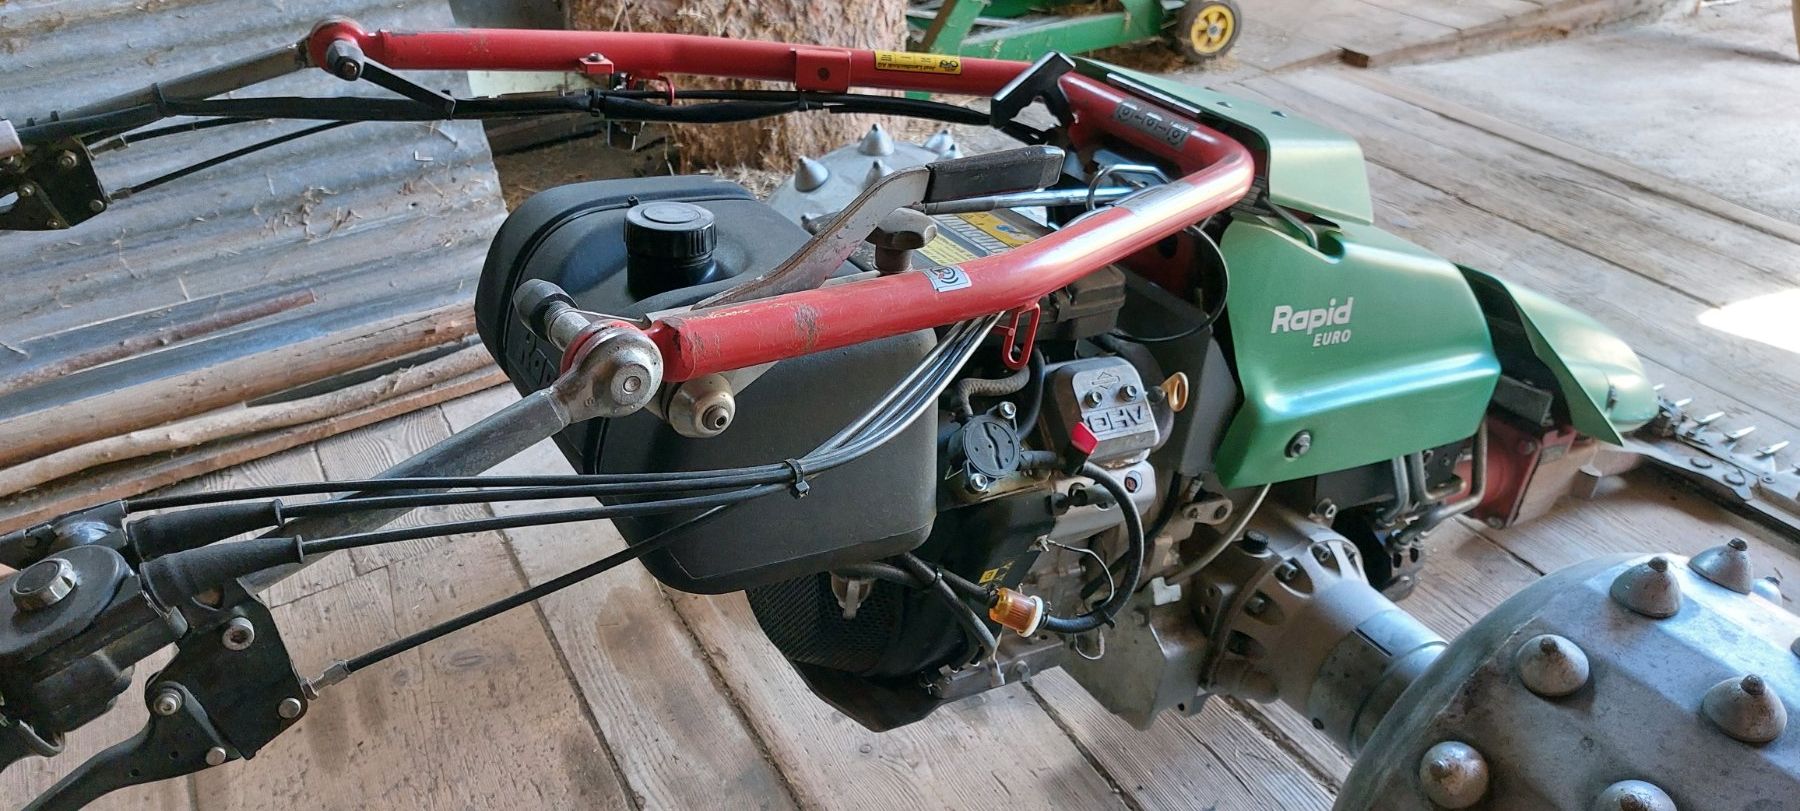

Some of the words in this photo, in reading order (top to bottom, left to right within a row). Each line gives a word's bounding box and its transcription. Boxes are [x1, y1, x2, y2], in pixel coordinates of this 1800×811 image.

[1271, 297, 1354, 335] Rapid
[1313, 329, 1351, 347] EURO
[1087, 404, 1144, 433] OHV
